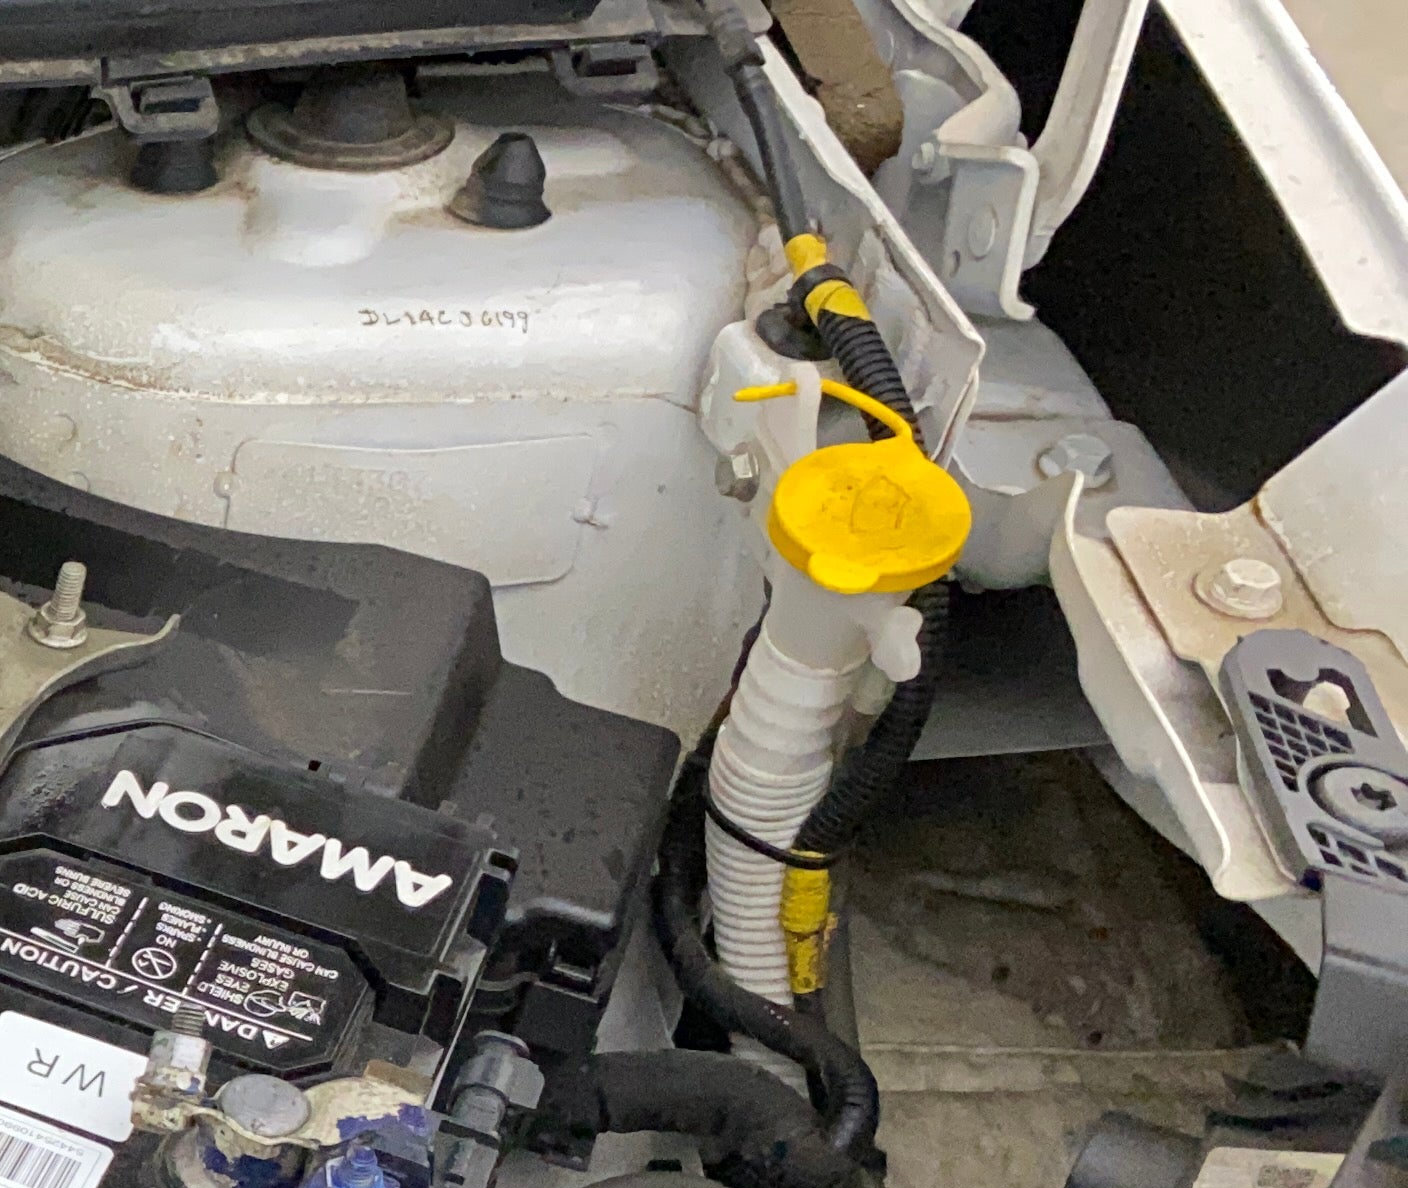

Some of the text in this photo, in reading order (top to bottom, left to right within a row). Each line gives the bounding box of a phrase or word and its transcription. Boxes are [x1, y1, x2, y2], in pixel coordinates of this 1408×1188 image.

[98, 767, 455, 912] AMARON
[52, 874, 127, 906] BLINDNESS OR
[54, 864, 131, 897] SEVERE BURNS
[11, 882, 117, 925] SULFURIC ACID
[62, 888, 121, 915] CAN CAUSE
[154, 932, 177, 949] NO
[220, 932, 339, 980] CAN CAUSE BLINDNESS
[252, 932, 310, 959] OR INJURY
[214, 972, 251, 992] EYES
[216, 958, 290, 992] EXPLOSIVE
[249, 955, 296, 979] GASES
[196, 979, 244, 1004] SHIELD
[141, 989, 258, 1041] DANER
